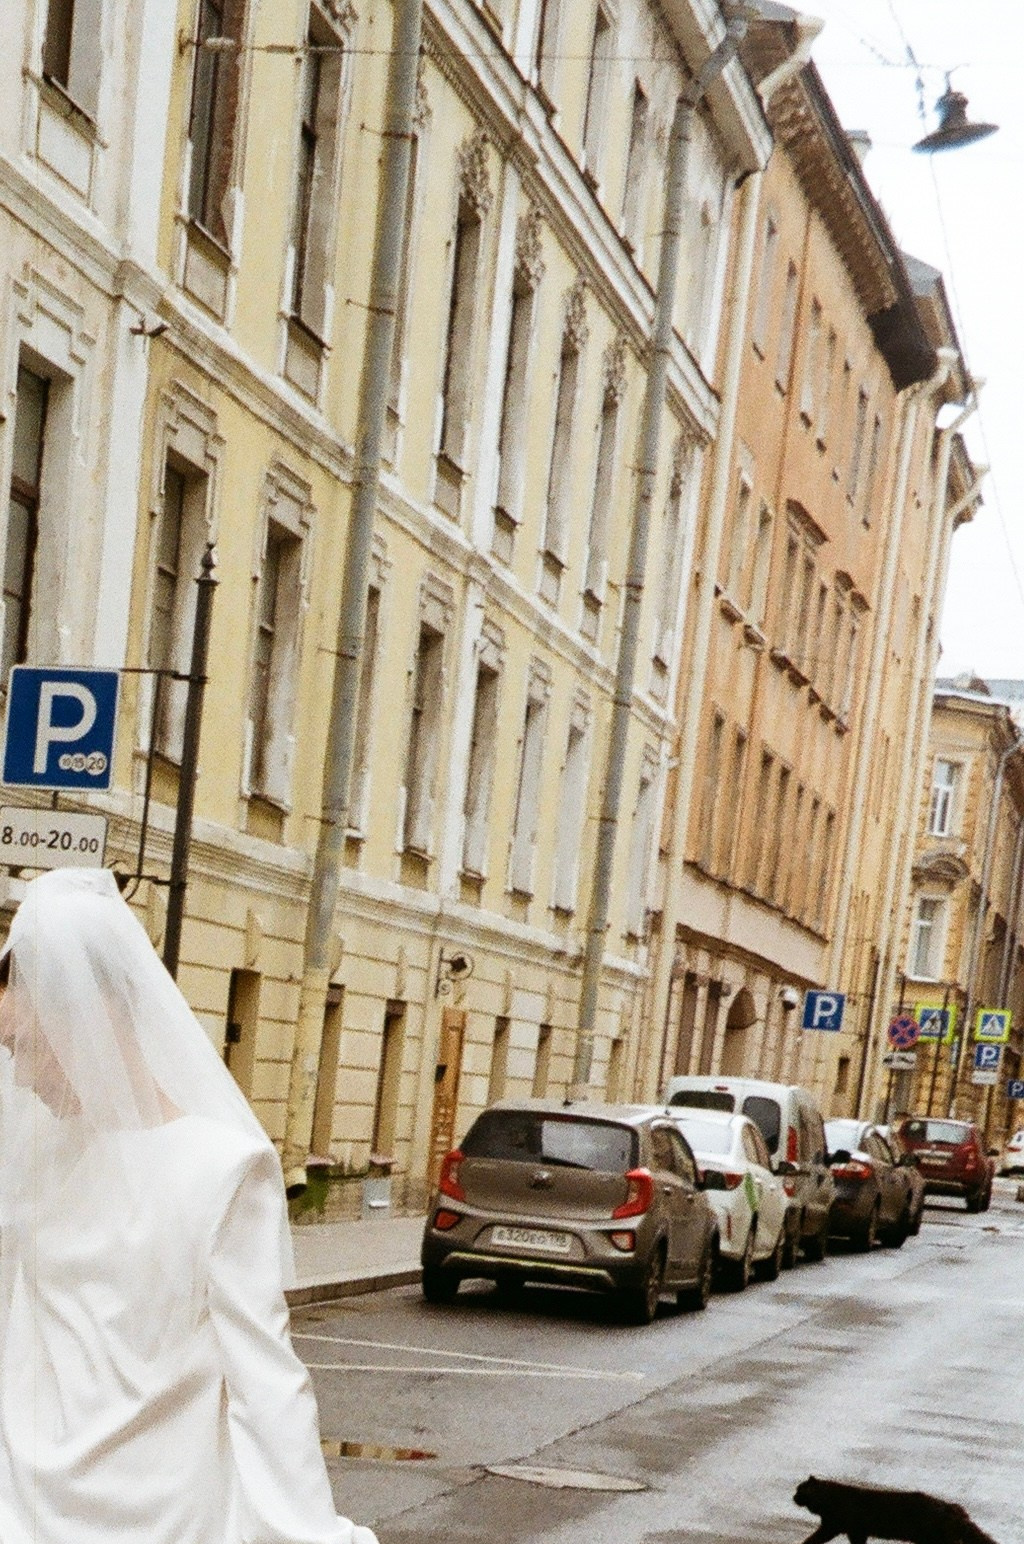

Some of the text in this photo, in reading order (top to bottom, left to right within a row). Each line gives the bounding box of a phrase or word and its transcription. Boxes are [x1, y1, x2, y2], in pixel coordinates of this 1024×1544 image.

[33, 681, 97, 774] P
[87, 756, 106, 771] 20
[1, 826, 99, 853] 8.00-20.00
[813, 995, 838, 1027] P
[980, 1046, 996, 1066] P
[1011, 1081, 1024, 1097] P
